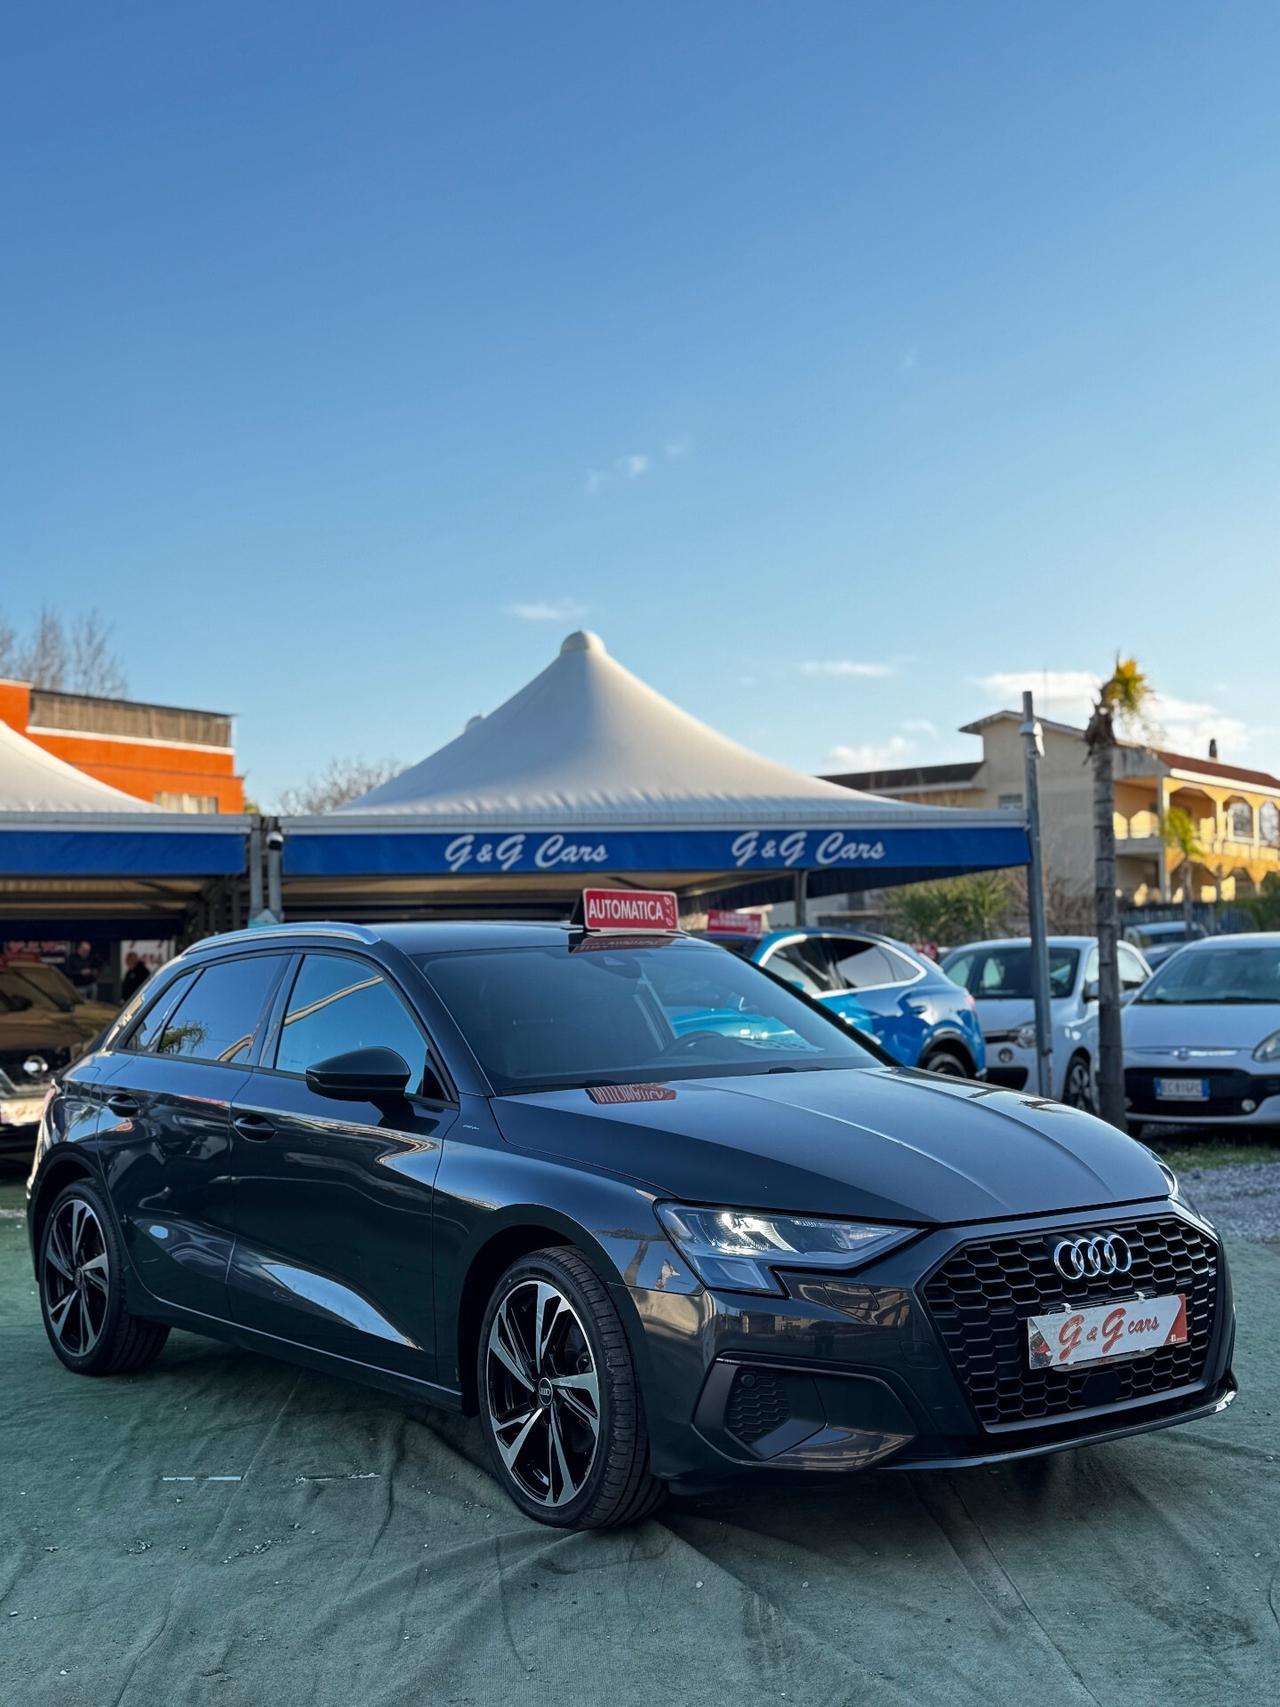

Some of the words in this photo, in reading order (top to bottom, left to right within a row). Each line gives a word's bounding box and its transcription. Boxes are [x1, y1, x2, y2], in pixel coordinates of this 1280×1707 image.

[534, 834, 608, 868] Cars
[816, 832, 886, 865] Cars
[588, 898, 664, 921] AUTOMATICA
[1128, 1315, 1160, 1335] cars
